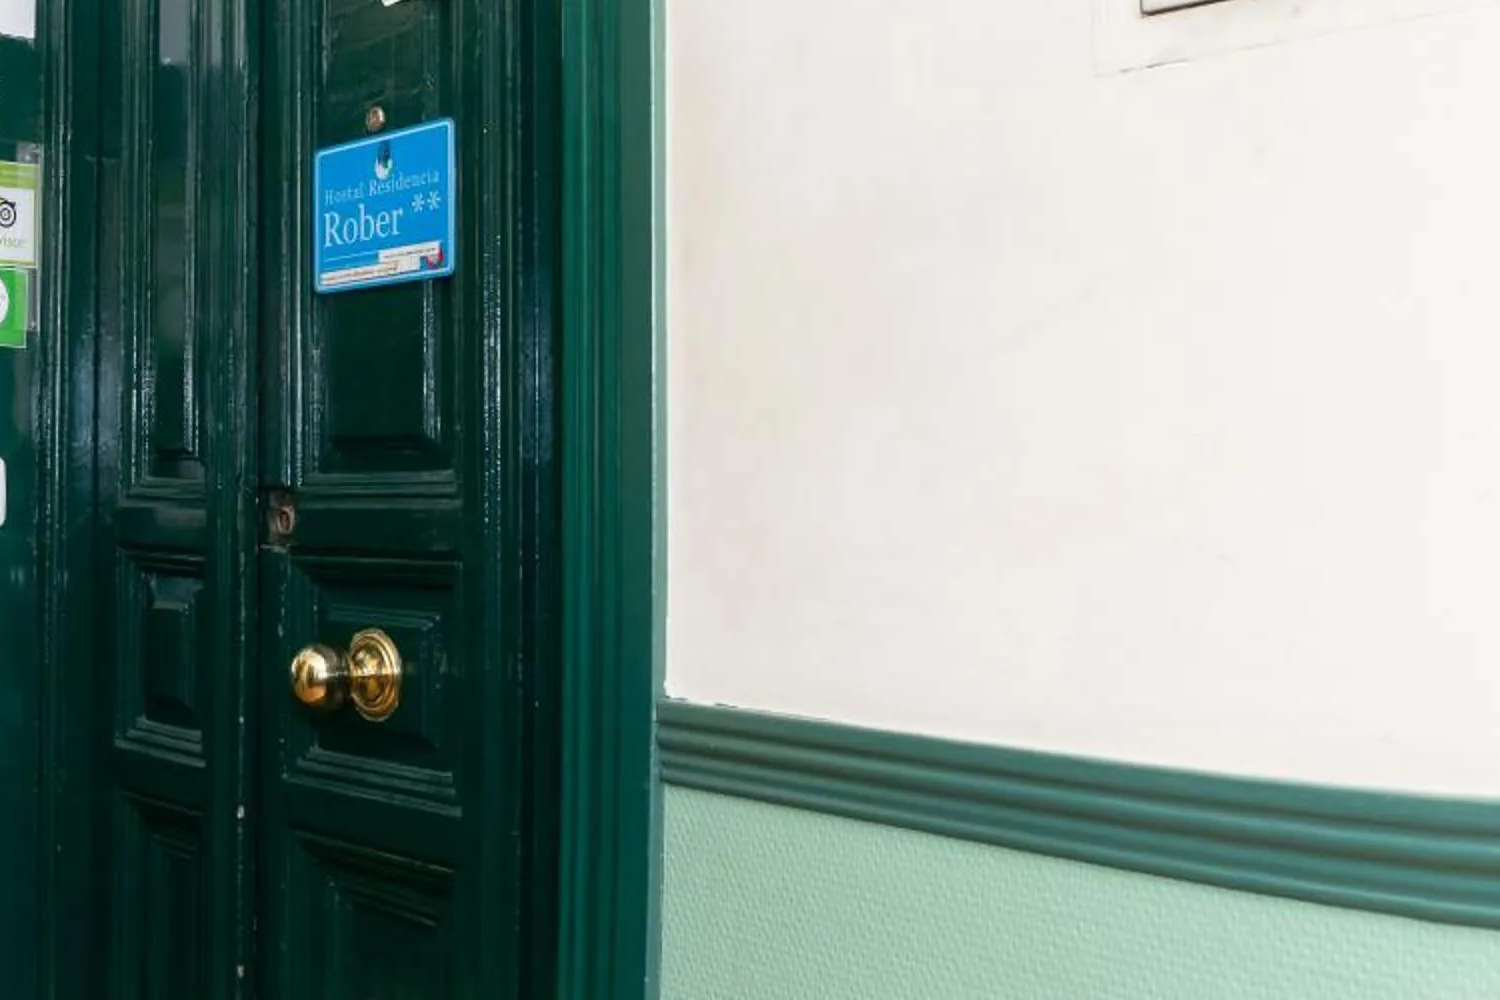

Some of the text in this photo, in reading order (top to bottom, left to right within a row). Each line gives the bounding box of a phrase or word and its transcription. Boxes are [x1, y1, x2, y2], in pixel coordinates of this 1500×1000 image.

[325, 168, 440, 205] Hostal Residencia
[324, 203, 404, 248] Rober
